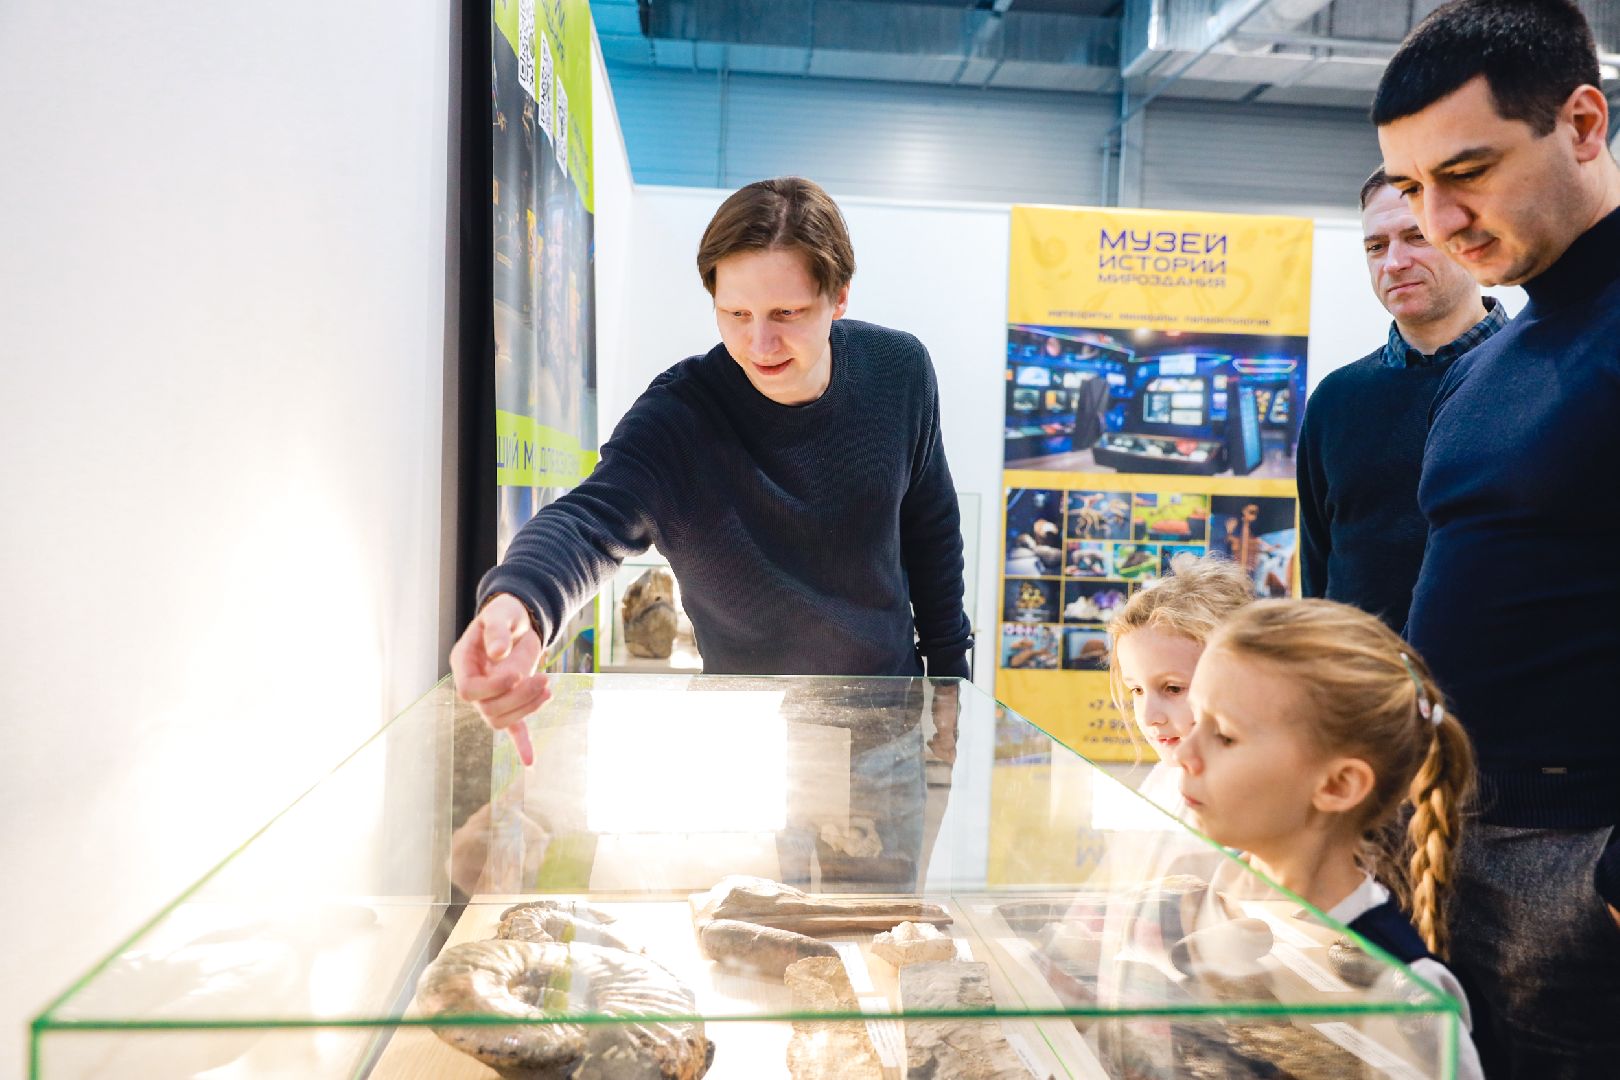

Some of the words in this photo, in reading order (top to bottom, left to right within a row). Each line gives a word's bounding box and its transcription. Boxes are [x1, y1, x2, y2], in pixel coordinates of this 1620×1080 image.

[1100, 229, 1227, 254] МУЗЕЙ
[1099, 254, 1227, 274] ИСТОРИИ
[1097, 273, 1226, 288] МИРОЗДАНИЯ
